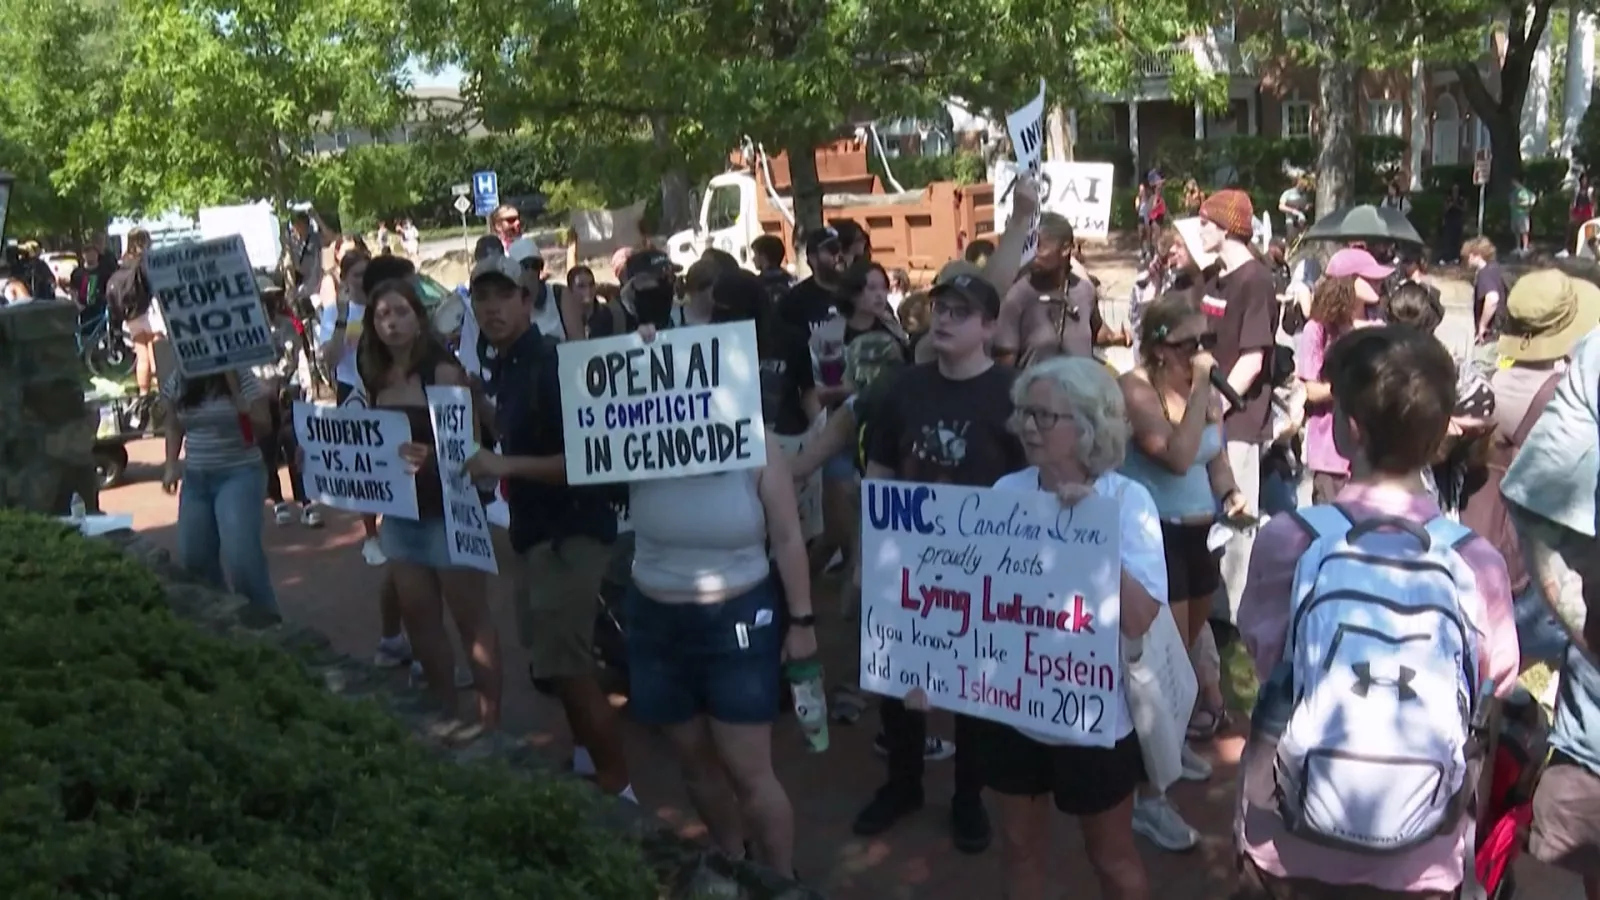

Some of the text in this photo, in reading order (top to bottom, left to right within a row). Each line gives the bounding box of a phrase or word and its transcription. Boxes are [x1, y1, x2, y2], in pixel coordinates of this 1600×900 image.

[478, 175, 493, 193] H
[1059, 177, 1102, 204] AI
[158, 272, 254, 312] PEOPLE
[170, 302, 256, 338] NOT
[178, 339, 210, 358] BIG
[213, 325, 266, 352] TECH!
[586, 337, 720, 398] OPEN AI
[577, 391, 712, 429] IS COMPLICIT
[306, 415, 385, 448] STUDENTS
[585, 418, 751, 475] IN GENOCIDE
[315, 475, 394, 503] BILLIONAIRES
[868, 483, 946, 537] UNC's
[958, 493, 1041, 541] Carolina
[1047, 506, 1108, 545] Inn
[915, 544, 1043, 576] proudly hosts
[901, 567, 1096, 638] Lying Lutnick
[912, 619, 958, 659] know,
[974, 628, 1007, 662] like
[1025, 632, 1113, 692] Epstein
[867, 652, 1105, 734] did on his Island in 2012
